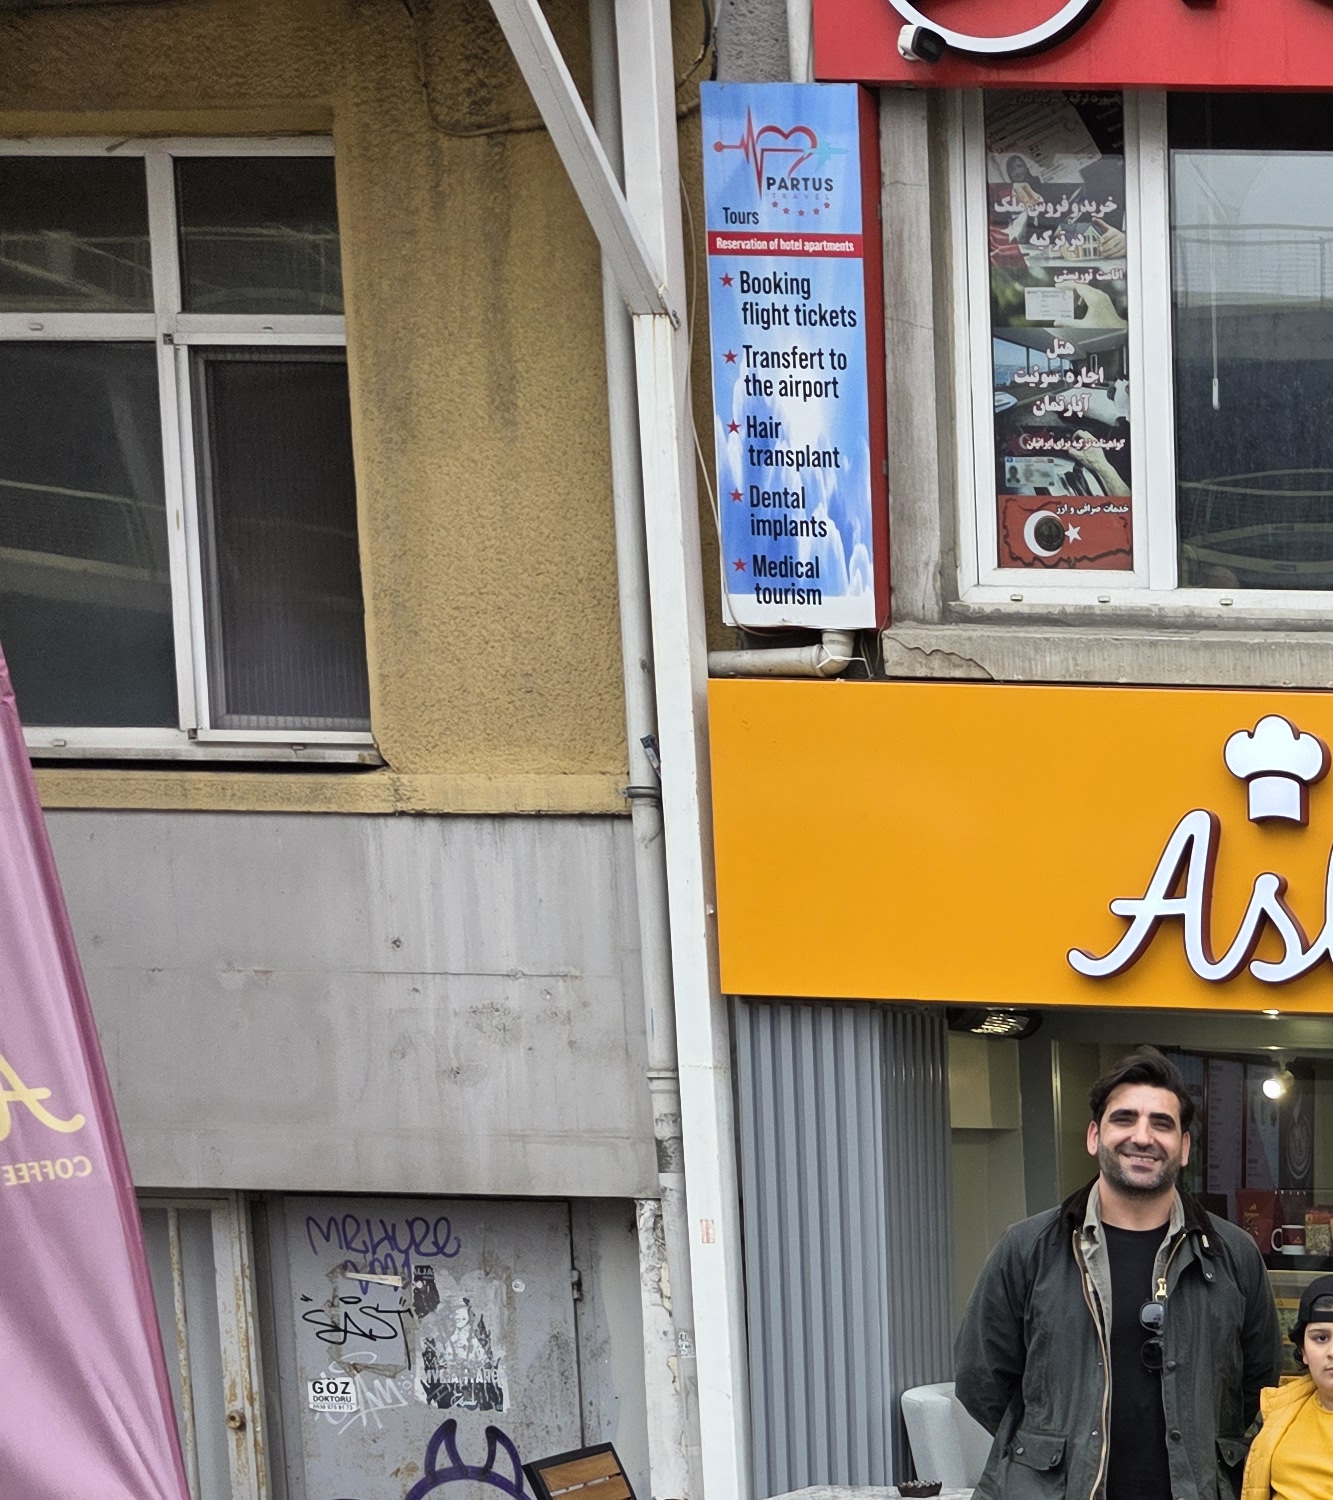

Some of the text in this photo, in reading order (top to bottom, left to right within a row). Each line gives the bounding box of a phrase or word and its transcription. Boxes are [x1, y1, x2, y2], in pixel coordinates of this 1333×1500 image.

[766, 176, 834, 192] PARTUS
[722, 207, 760, 225] Tours
[716, 237, 855, 253] Reservation of hotel apartments
[739, 270, 811, 300] Booking
[741, 301, 857, 331] flight tickets
[742, 344, 848, 372] Transfert to
[743, 372, 840, 403] the airport
[746, 416, 782, 440] Hair
[748, 444, 841, 472] transplant
[749, 485, 806, 510] Dental
[750, 513, 828, 541] implants
[752, 555, 820, 580] Medical
[754, 582, 823, 607] tourism
[312, 1377, 352, 1394] GÖZ
